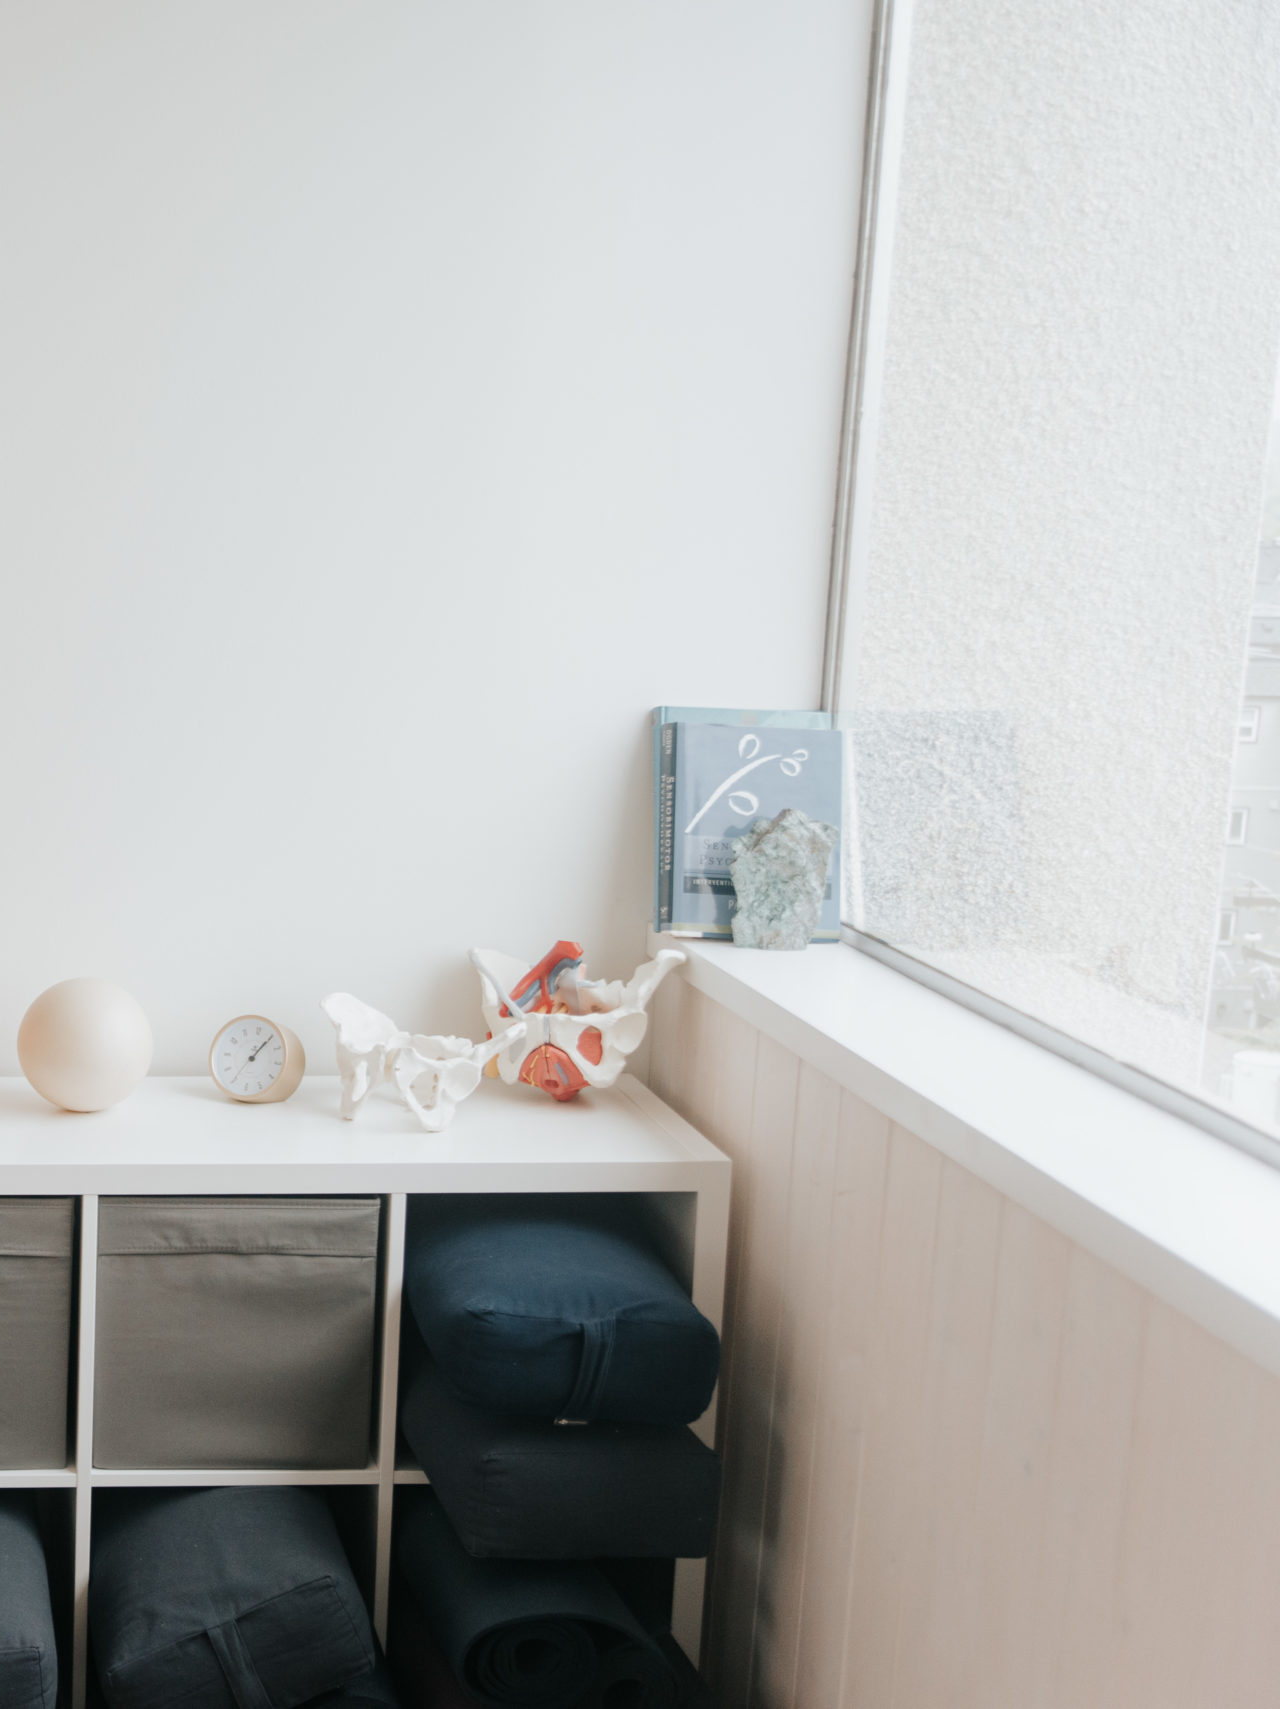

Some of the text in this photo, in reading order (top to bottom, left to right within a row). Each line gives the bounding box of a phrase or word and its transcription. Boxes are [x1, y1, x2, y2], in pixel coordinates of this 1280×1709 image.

[665, 775, 675, 871] SENSORIMOTOR
[704, 839, 730, 851] SEN
[699, 855, 732, 866] PSYC
